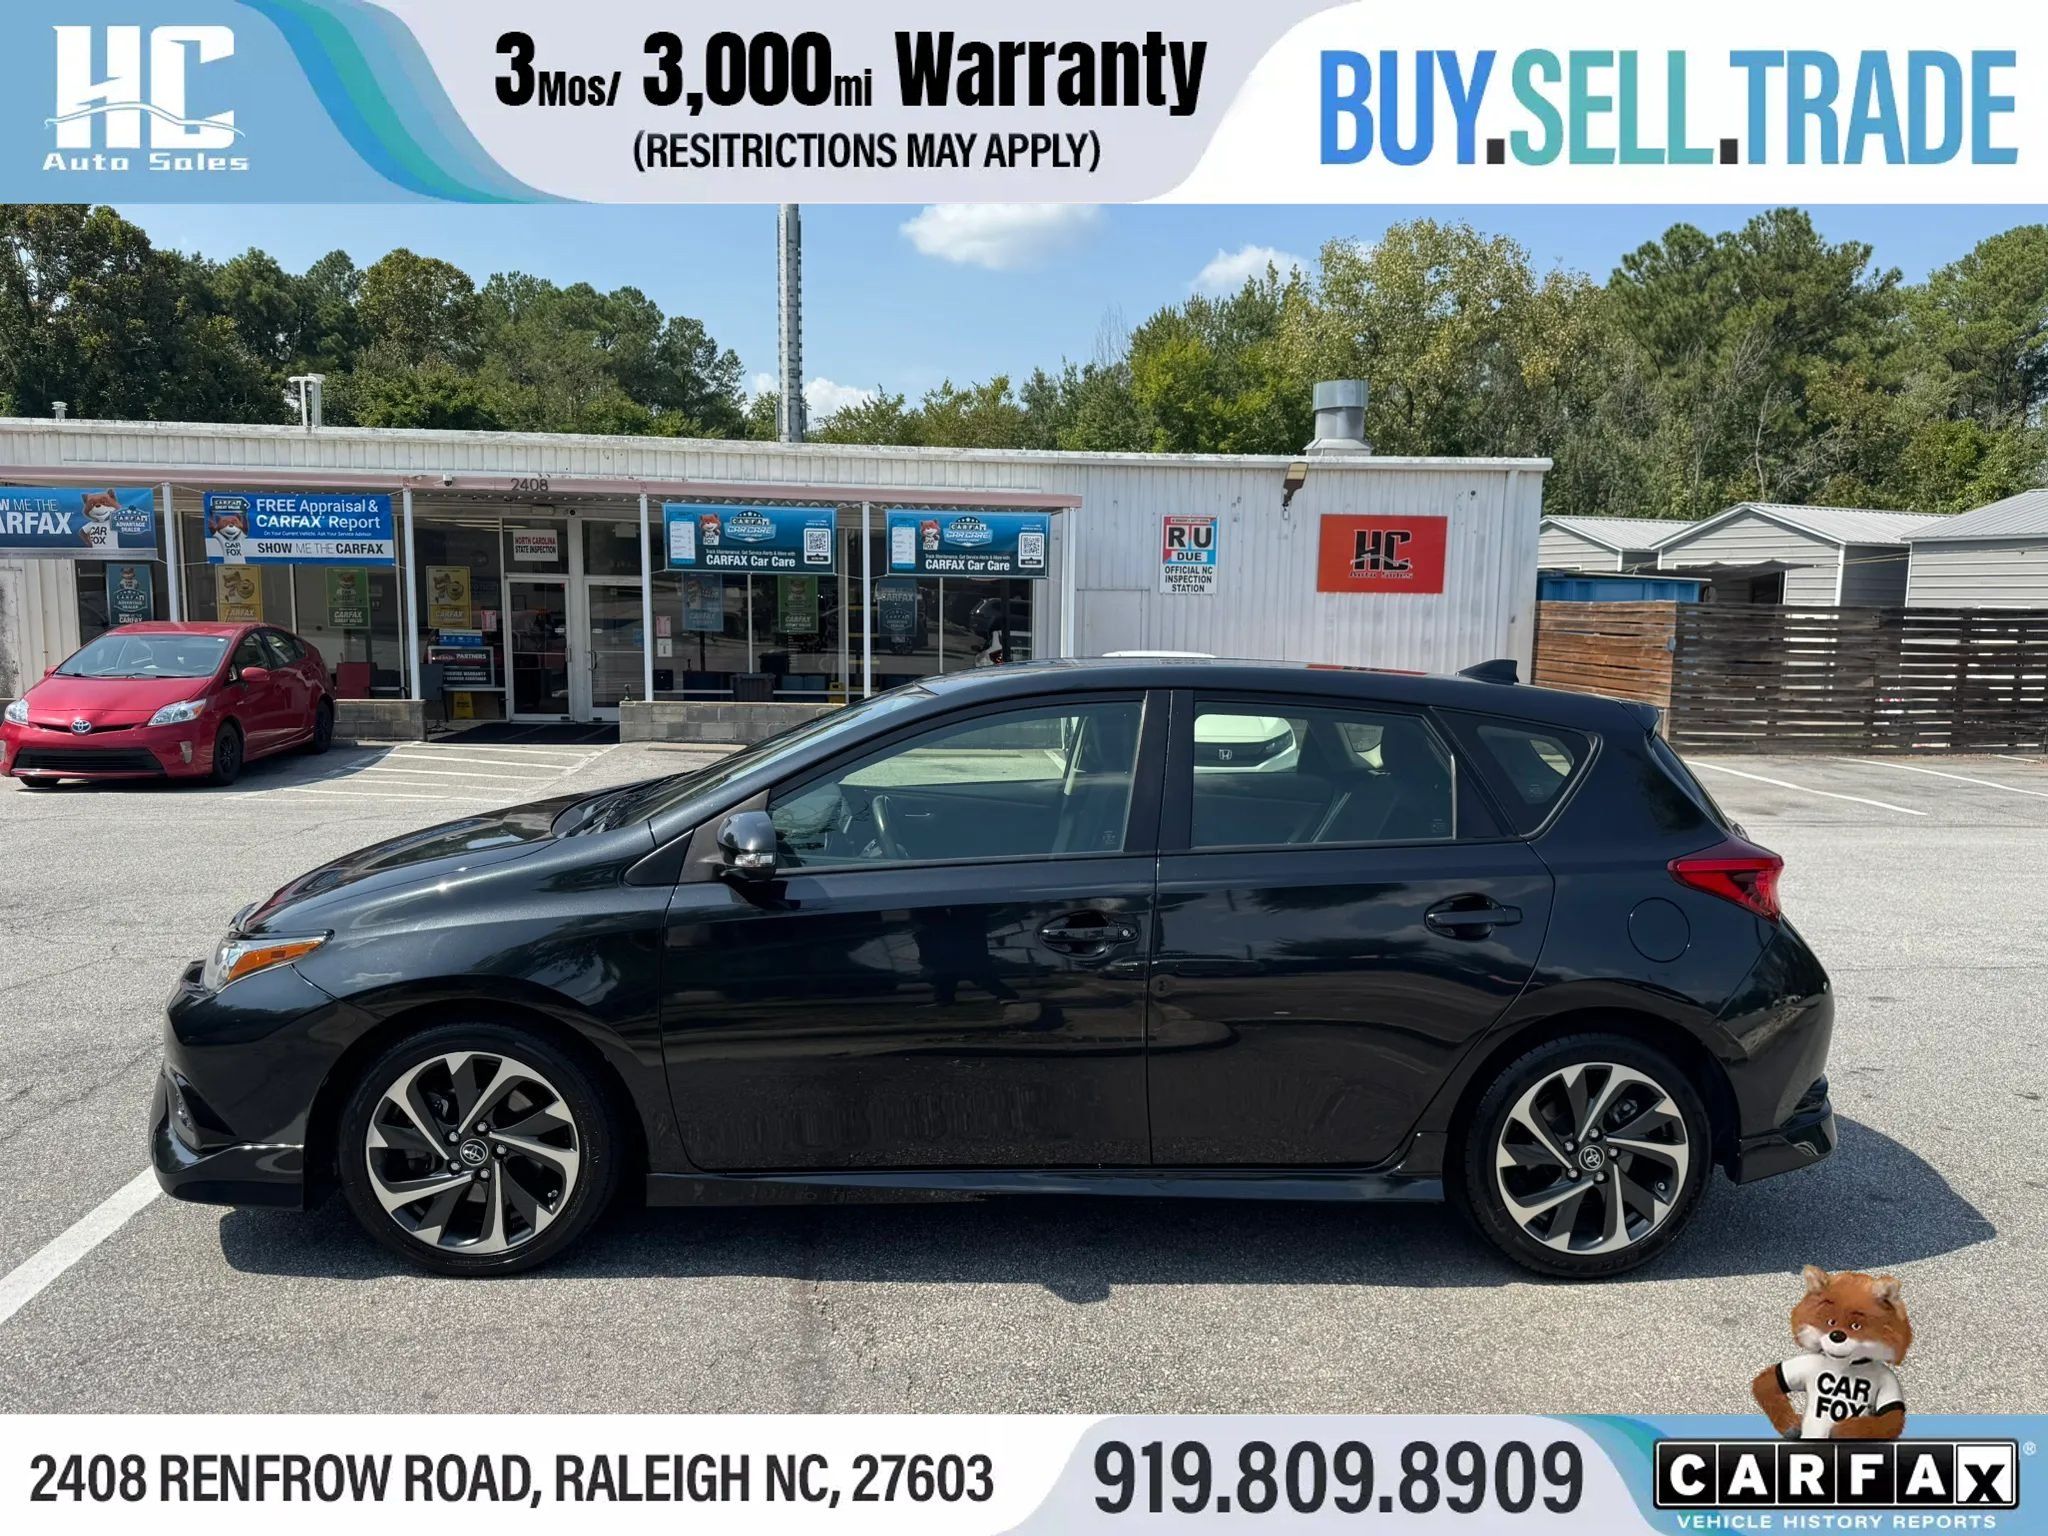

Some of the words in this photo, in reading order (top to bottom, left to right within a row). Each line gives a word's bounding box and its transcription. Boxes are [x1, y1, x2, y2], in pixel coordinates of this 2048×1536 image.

[510, 478, 549, 492] 2408
[13, 498, 32, 512] ME
[34, 498, 58, 512] THE
[256, 498, 296, 512] FREE
[300, 499, 366, 516] Appraisal
[368, 500, 378, 513] &
[256, 515, 322, 528] CARFAX
[328, 516, 380, 532] Report
[90, 526, 107, 536] CAR
[515, 536, 531, 544] NORTH
[532, 536, 556, 544] CAROLINA
[1168, 527, 1186, 548] R
[1194, 527, 1212, 548] U
[257, 543, 292, 554] SHOW
[295, 544, 312, 554] ME
[314, 544, 334, 554] THE
[336, 544, 384, 554] CARFAX
[530, 546, 556, 554] INSPECTION
[1353, 529, 1413, 572] HC
[706, 555, 748, 566] CARFAX
[750, 556, 768, 566] Car
[771, 556, 796, 567] Care
[1177, 552, 1202, 560] DUE
[926, 560, 965, 570] CARFAX
[968, 560, 985, 570] Car
[987, 560, 1010, 571] Care
[1164, 566, 1200, 574] OFFICIAL
[1202, 566, 1213, 574] NC
[1164, 575, 1212, 584] INSPECTION
[1172, 584, 1205, 592] STATION
[881, 592, 914, 602] CARFAX
